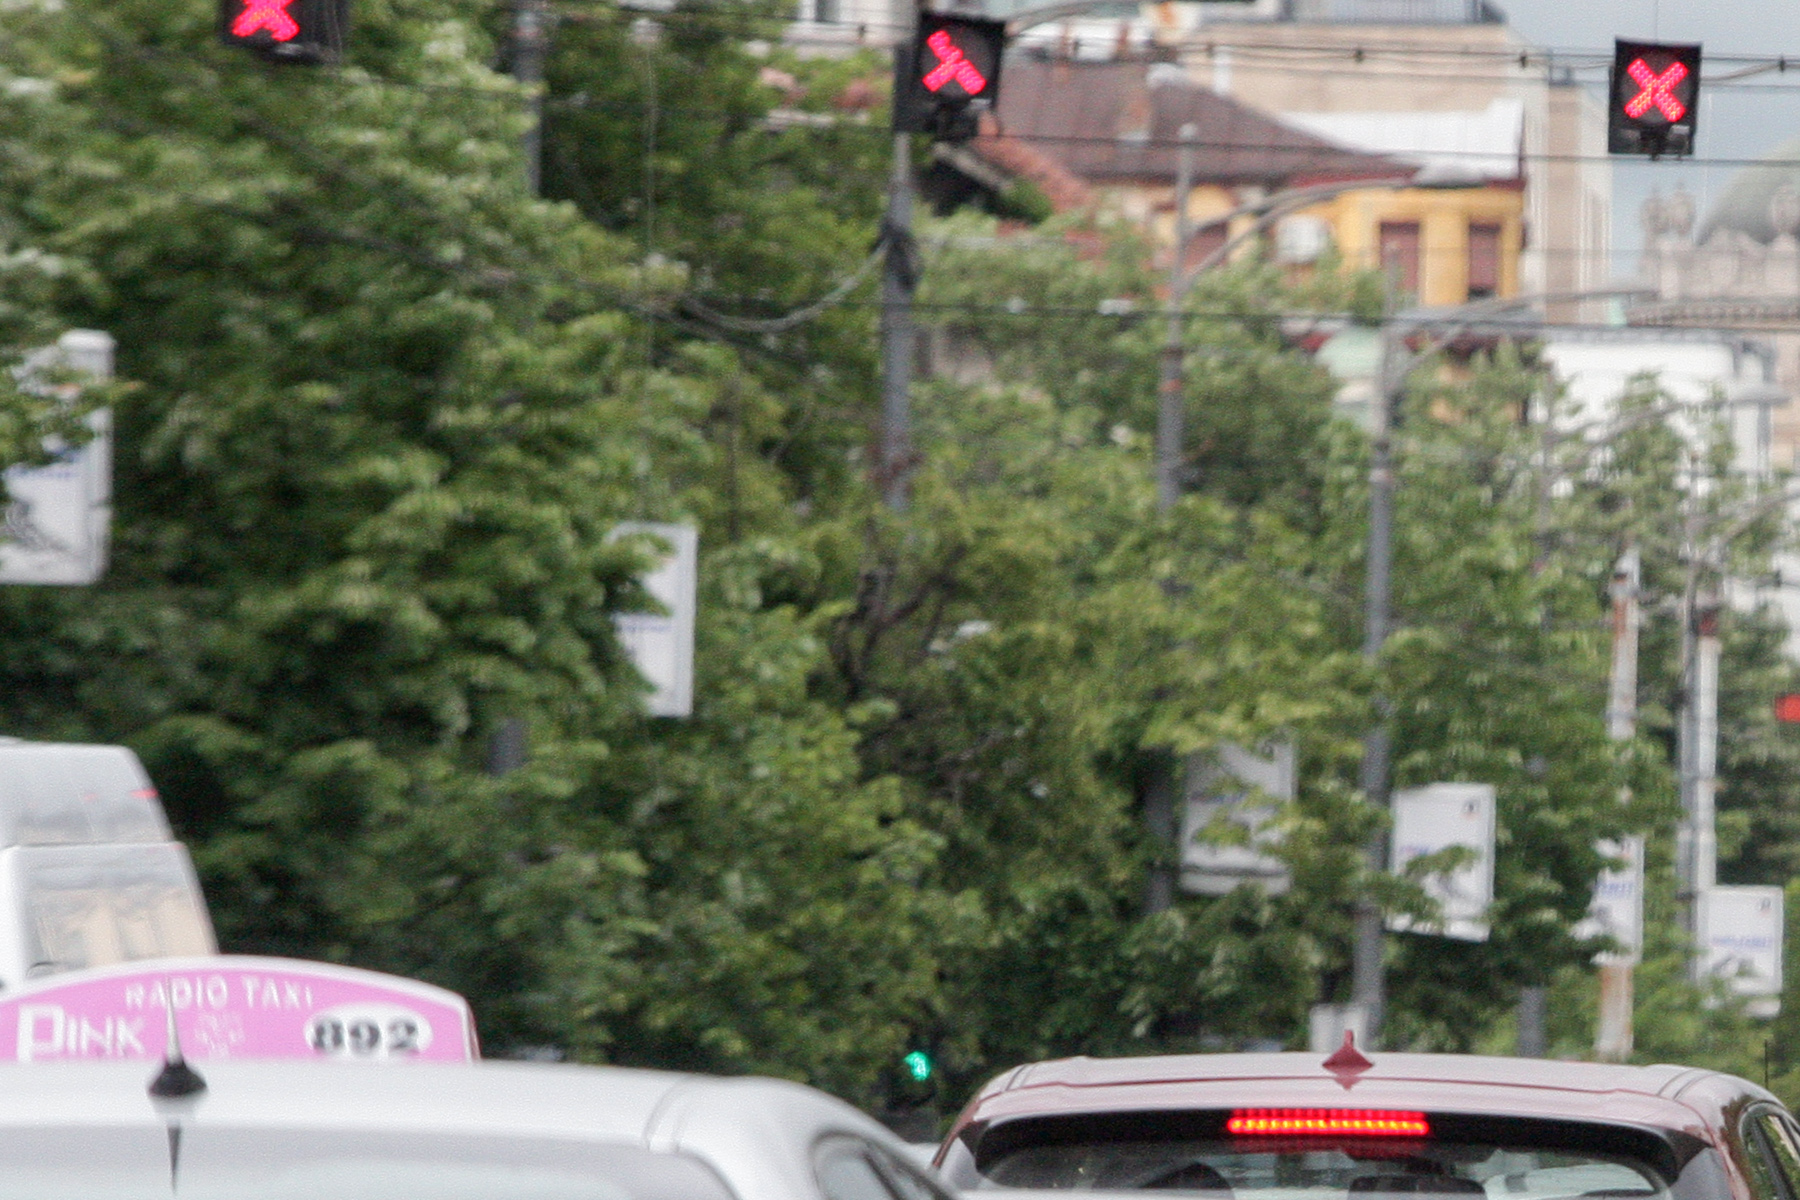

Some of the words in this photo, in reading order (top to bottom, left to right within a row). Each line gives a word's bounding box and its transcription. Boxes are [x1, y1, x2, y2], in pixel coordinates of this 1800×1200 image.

[125, 974, 229, 1010] RADIO
[241, 975, 313, 1010] TAXI
[311, 1016, 419, 1057] 892
